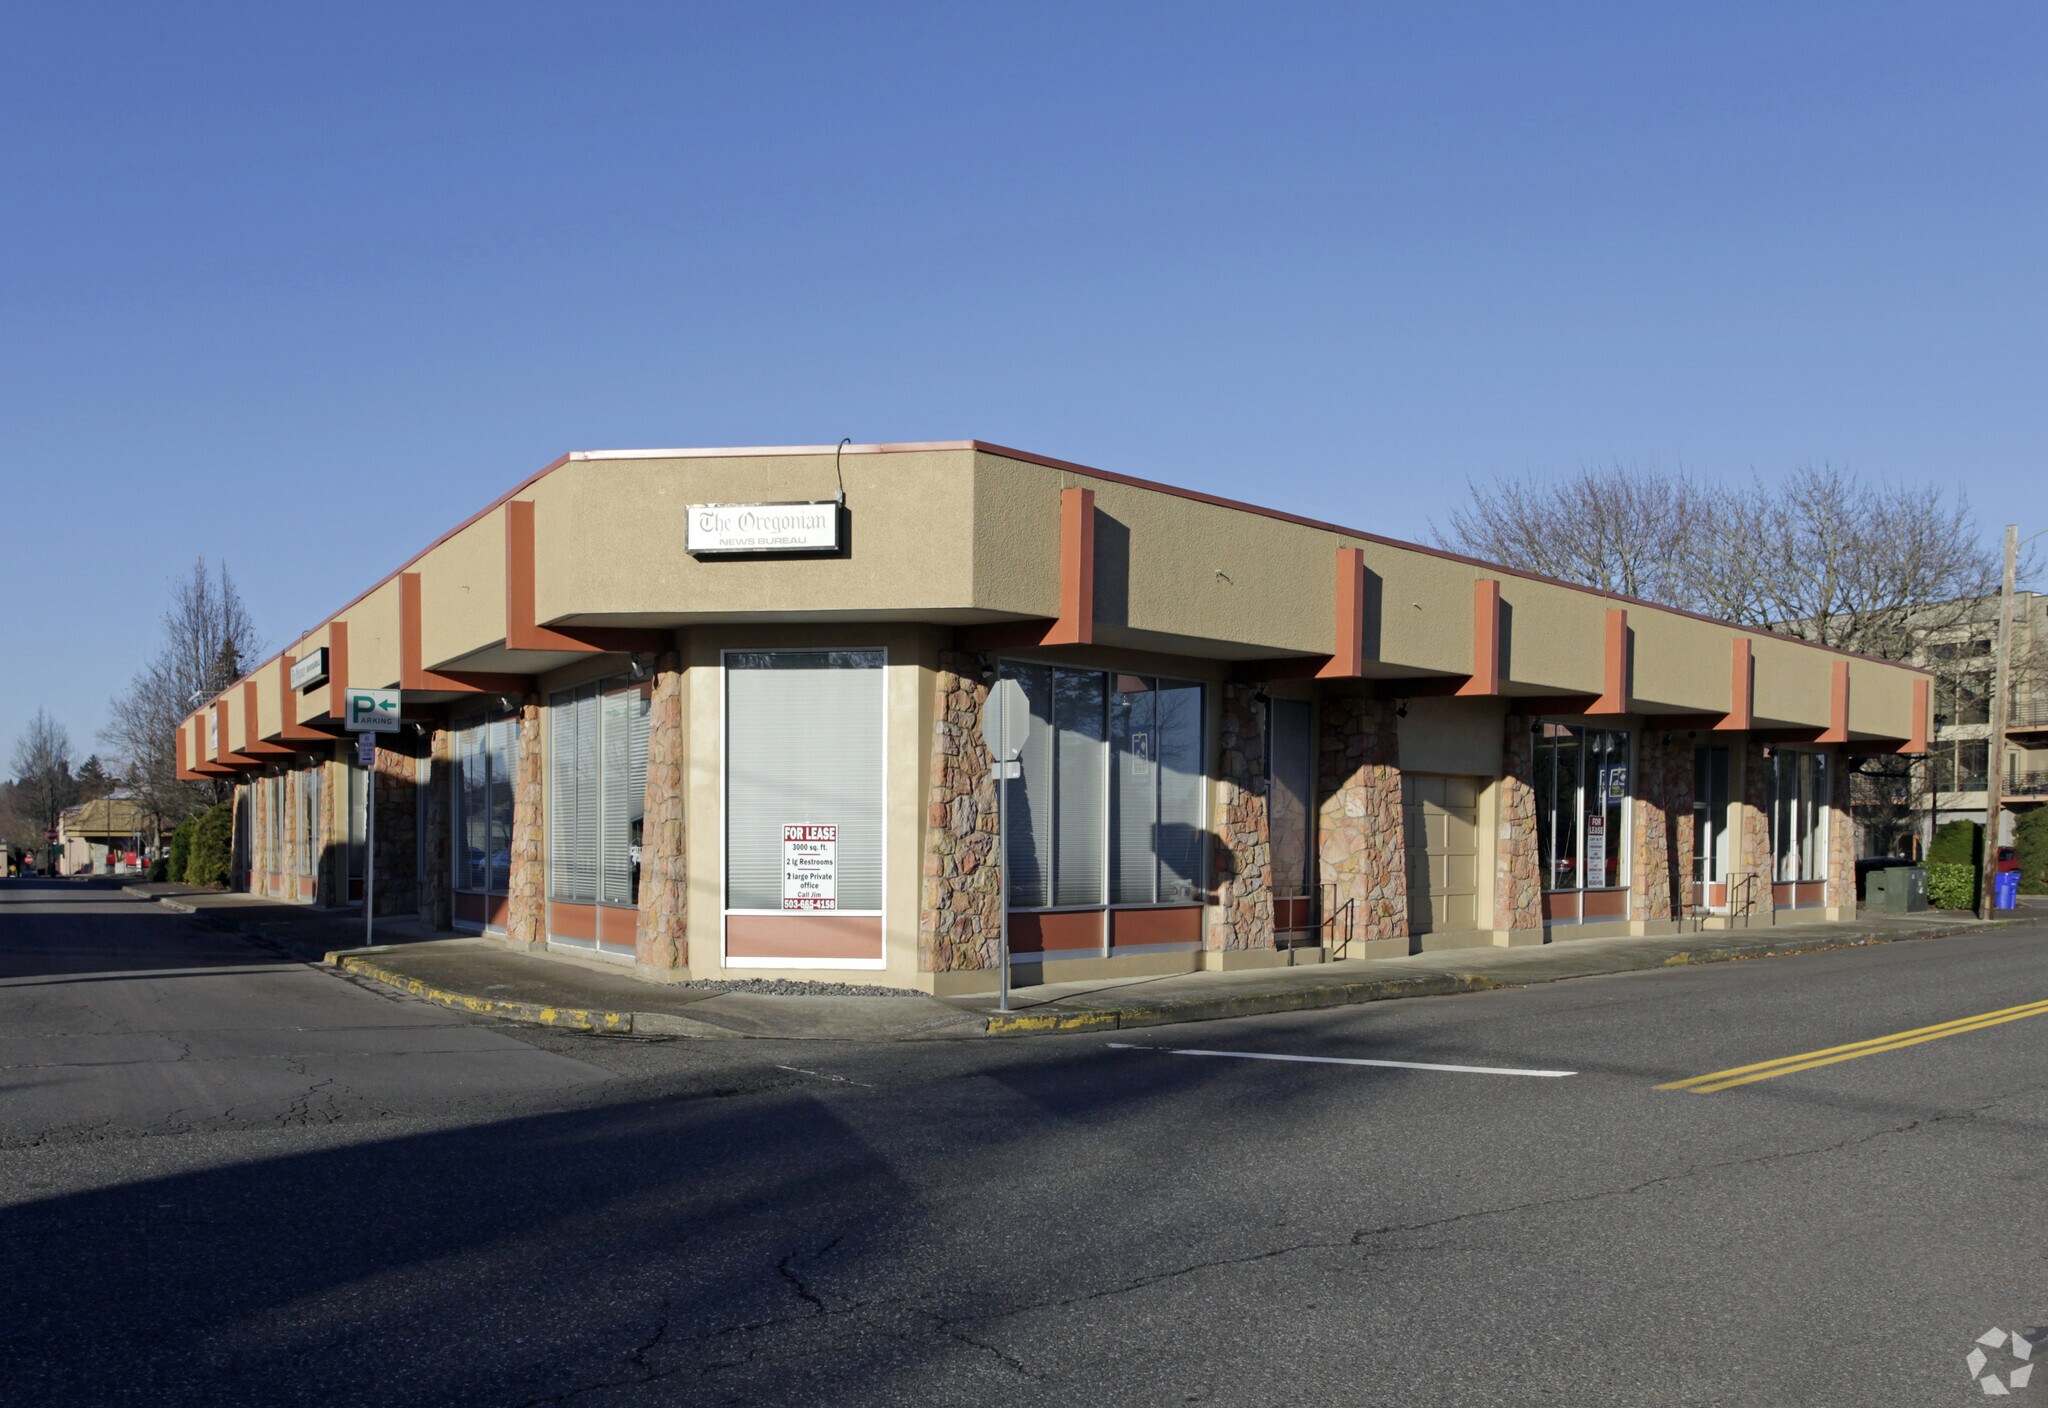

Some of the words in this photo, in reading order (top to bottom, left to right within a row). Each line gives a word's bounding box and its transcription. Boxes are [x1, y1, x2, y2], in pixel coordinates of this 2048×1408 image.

[699, 511, 731, 537] The
[738, 510, 827, 535] Oregonian
[719, 538, 755, 546] NEWS
[758, 537, 807, 545] BUREAU
[353, 695, 392, 725] PARKING
[1592, 817, 1602, 826] FOR
[784, 827, 803, 840] FOR
[806, 827, 835, 840] LEASE
[1589, 826, 1604, 834] LEASE
[793, 873, 808, 881] large
